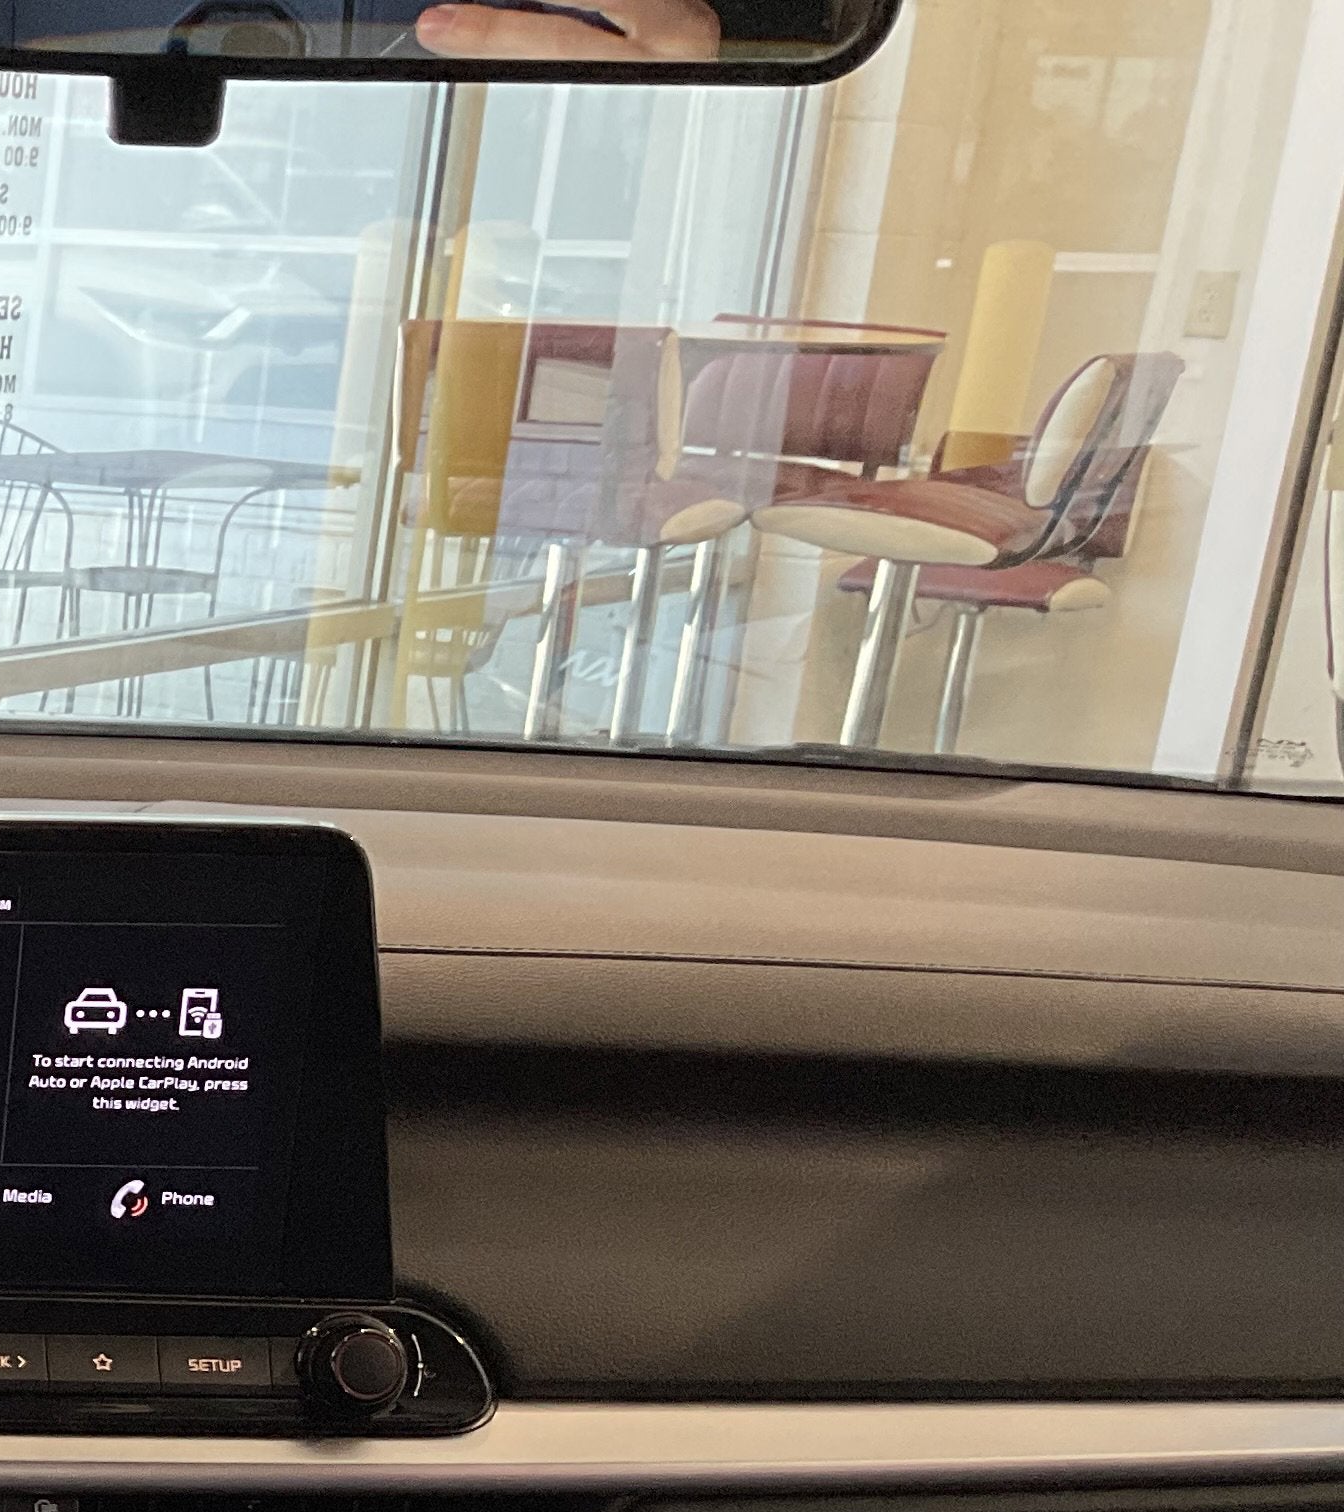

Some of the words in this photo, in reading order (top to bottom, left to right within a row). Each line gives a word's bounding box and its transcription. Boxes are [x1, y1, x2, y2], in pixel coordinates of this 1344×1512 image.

[32, 1053, 52, 1068] To
[54, 1055, 95, 1069] start
[97, 1056, 185, 1071] connecting
[187, 1056, 250, 1070] Android
[28, 1075, 67, 1089] Auto
[69, 1078, 88, 1089] or
[90, 1075, 136, 1091] Apple
[203, 1079, 249, 1092] press
[92, 1096, 123, 1110] this
[125, 1096, 180, 1112] widget.
[2, 1188, 54, 1204] Media
[161, 1191, 215, 1206] Phone
[187, 1357, 242, 1373] SETUP
